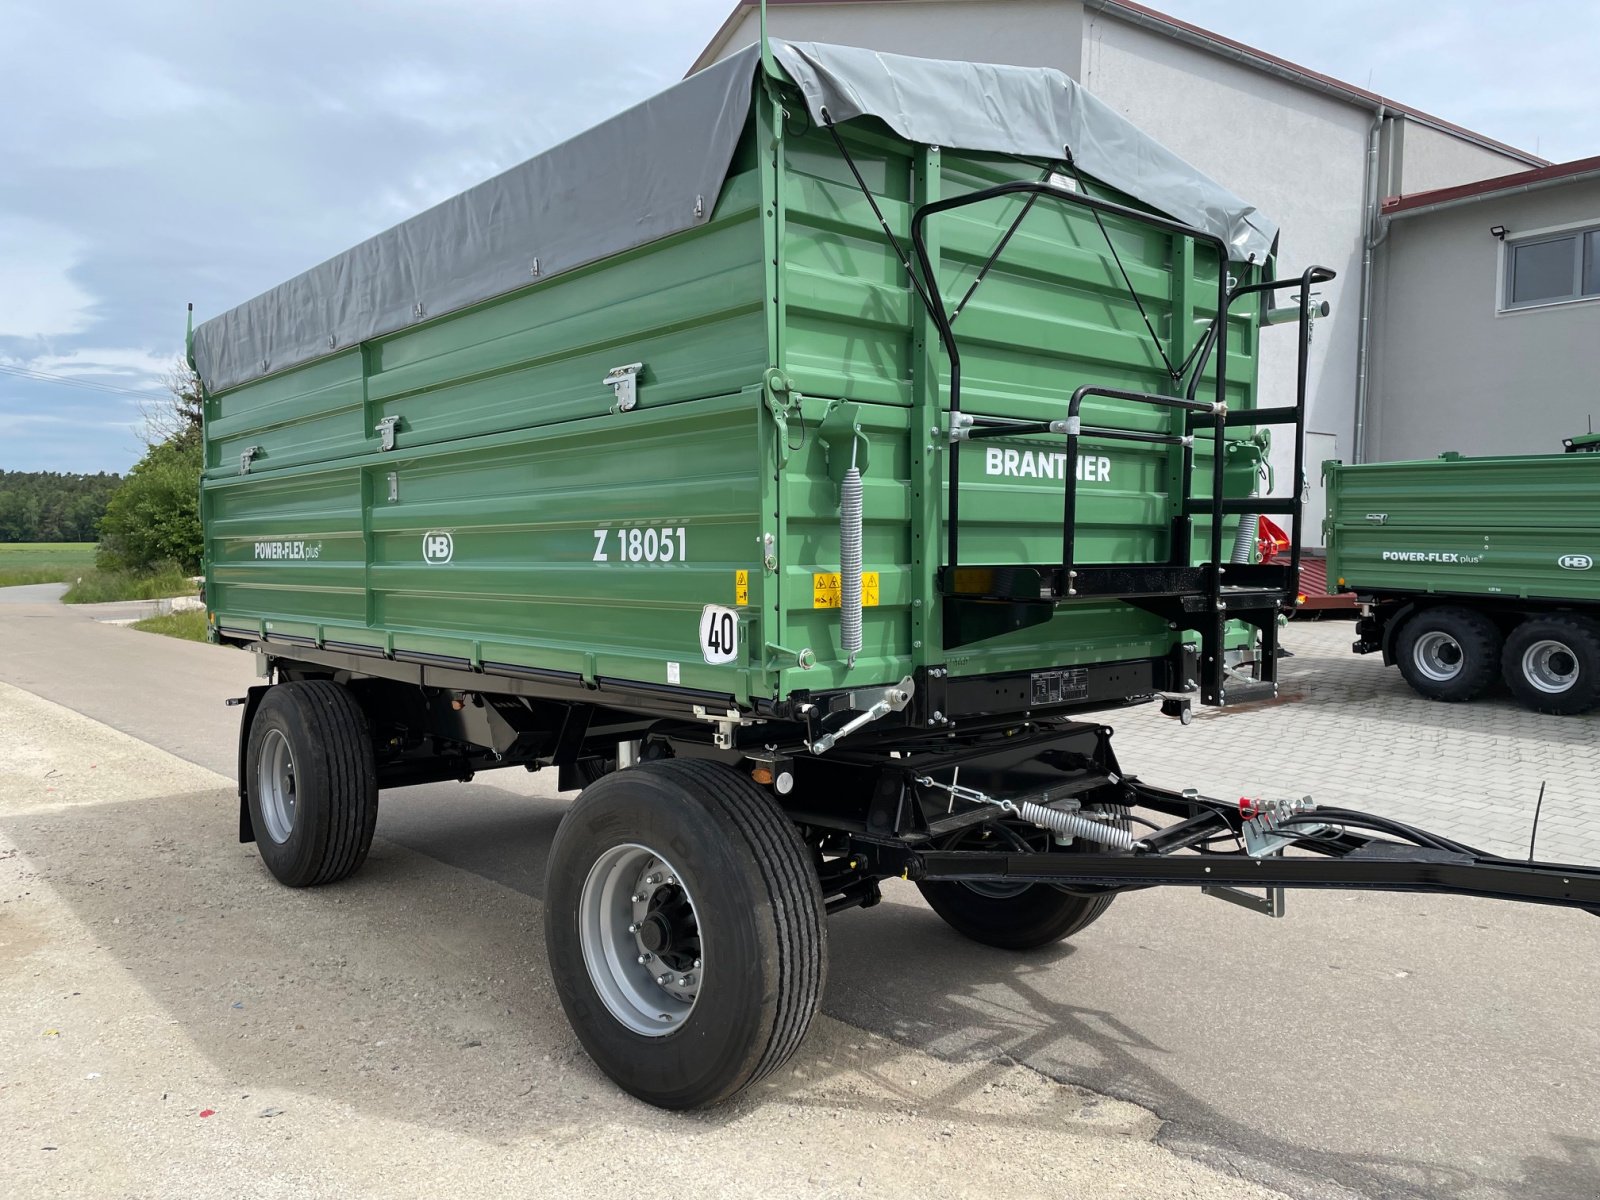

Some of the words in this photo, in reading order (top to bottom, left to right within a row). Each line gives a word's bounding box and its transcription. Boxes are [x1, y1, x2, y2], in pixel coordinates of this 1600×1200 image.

[254, 541, 305, 559] POWER-FLEX
[427, 536, 449, 558] HB
[592, 529, 608, 562] Z
[617, 527, 686, 562] 18051
[1382, 551, 1459, 563] POWER-FLEX
[708, 612, 734, 655] 40
